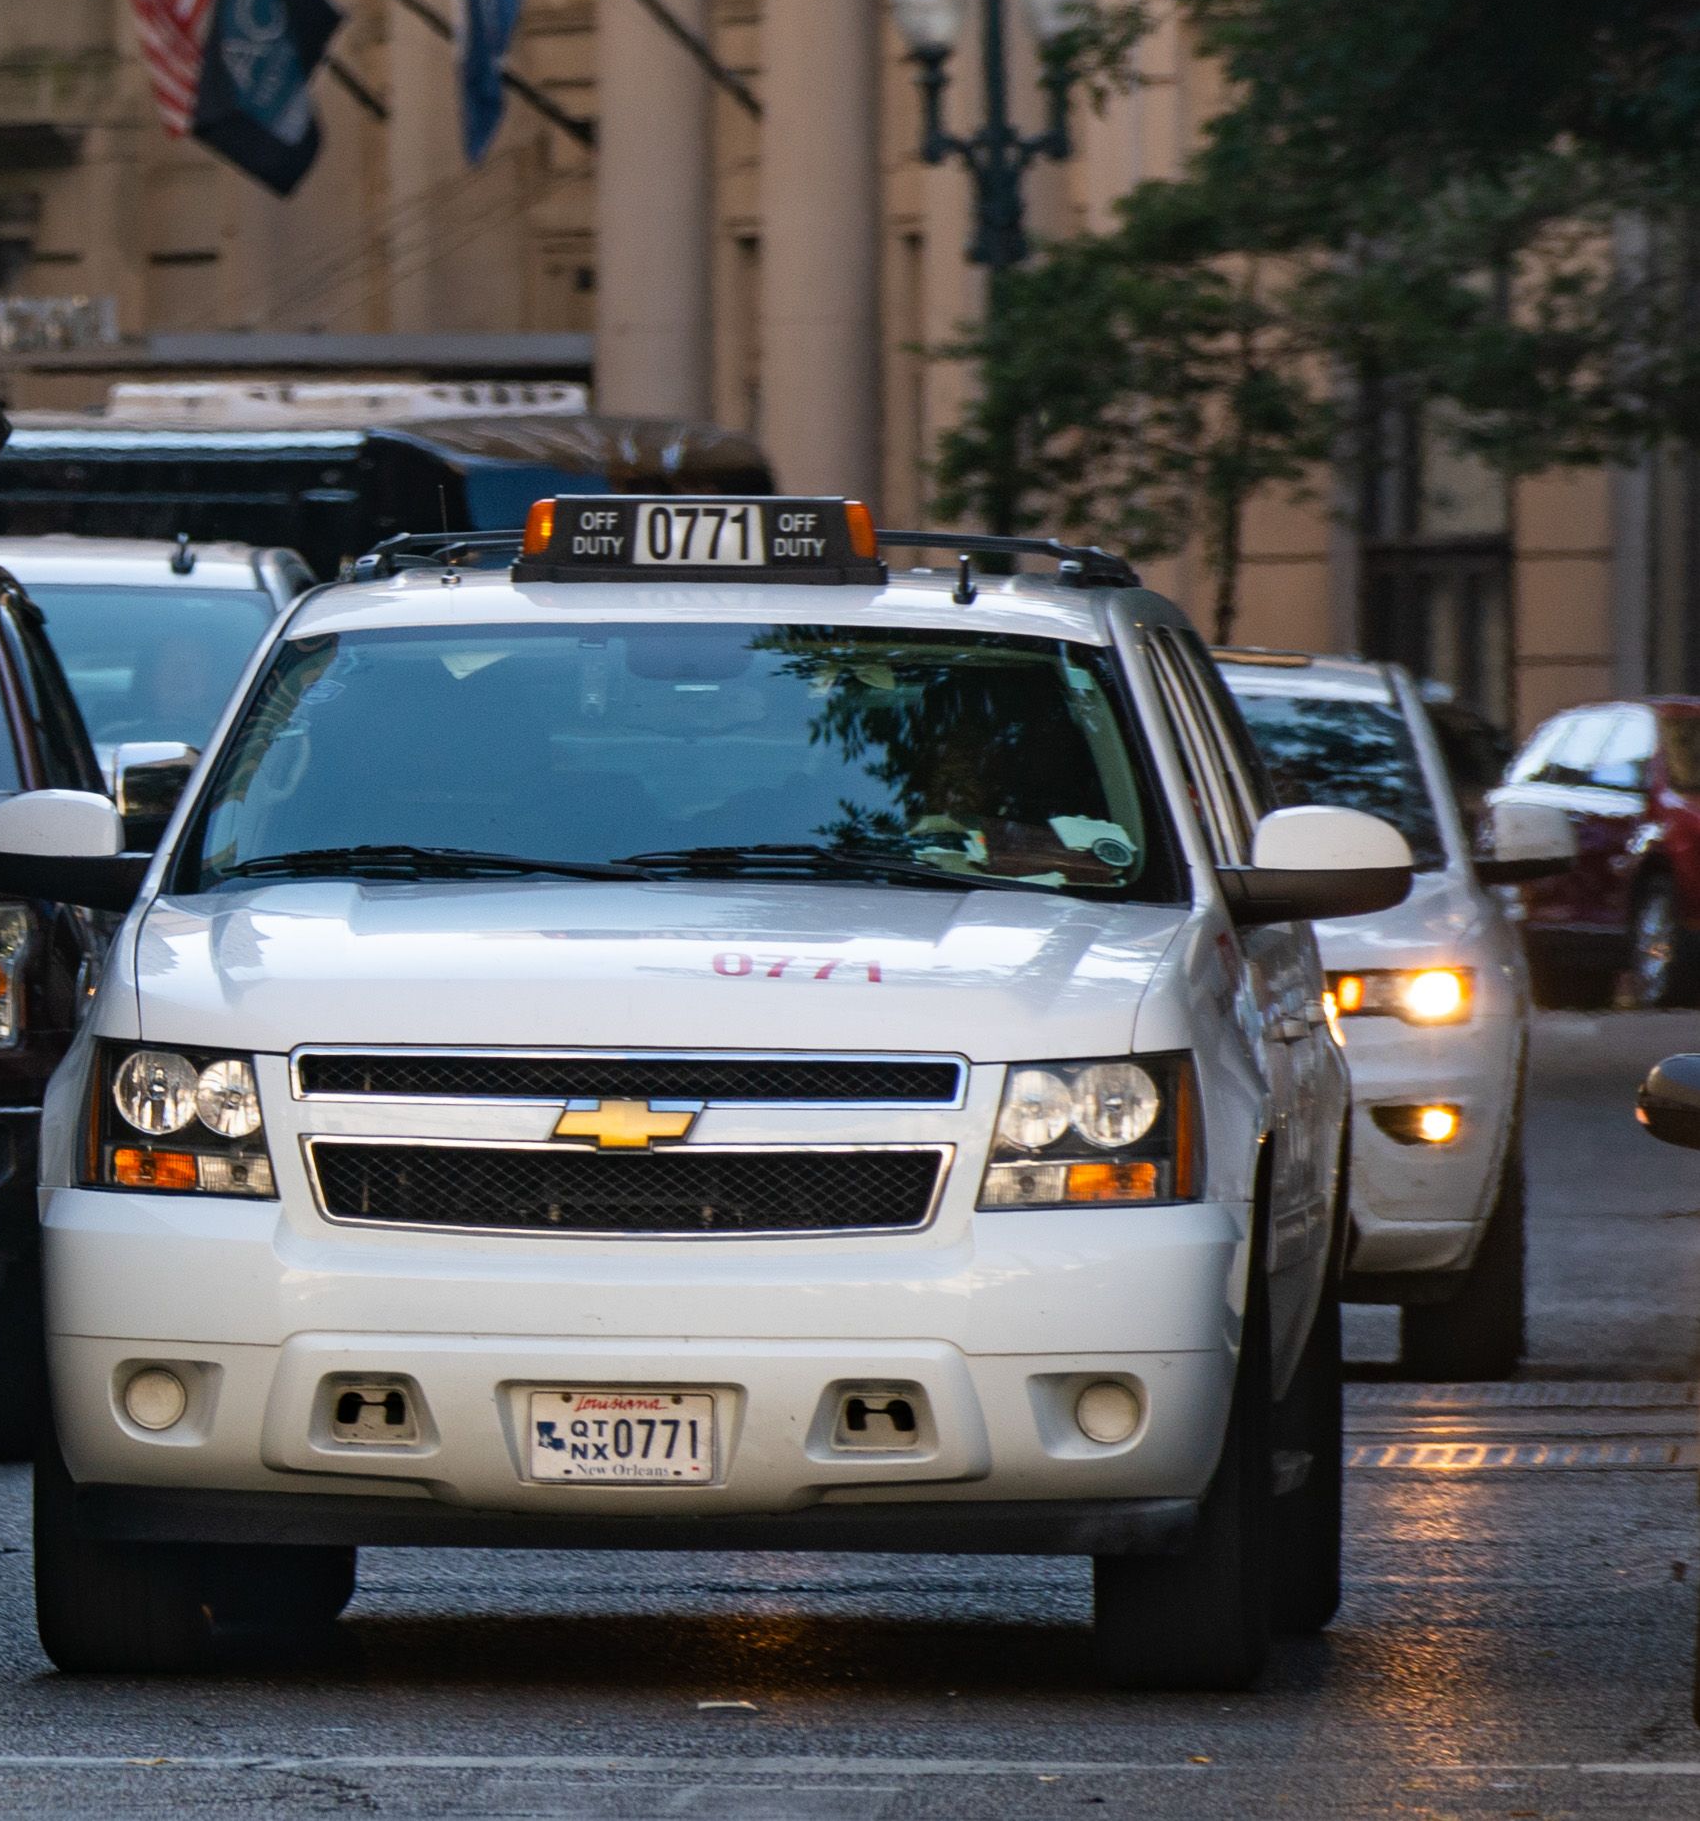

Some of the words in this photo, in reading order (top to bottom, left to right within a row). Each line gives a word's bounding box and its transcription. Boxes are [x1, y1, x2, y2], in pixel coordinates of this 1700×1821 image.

[579, 511, 619, 531] OFF
[778, 513, 817, 532] OFF
[647, 505, 751, 561] 0771
[573, 536, 624, 556] DUTY
[773, 537, 826, 557] DUTY
[712, 952, 883, 983] 0771
[574, 1395, 669, 1412] Louisiana
[613, 1418, 698, 1459] 0771
[576, 1463, 608, 1477] New
[612, 1463, 670, 1477] Orleans
